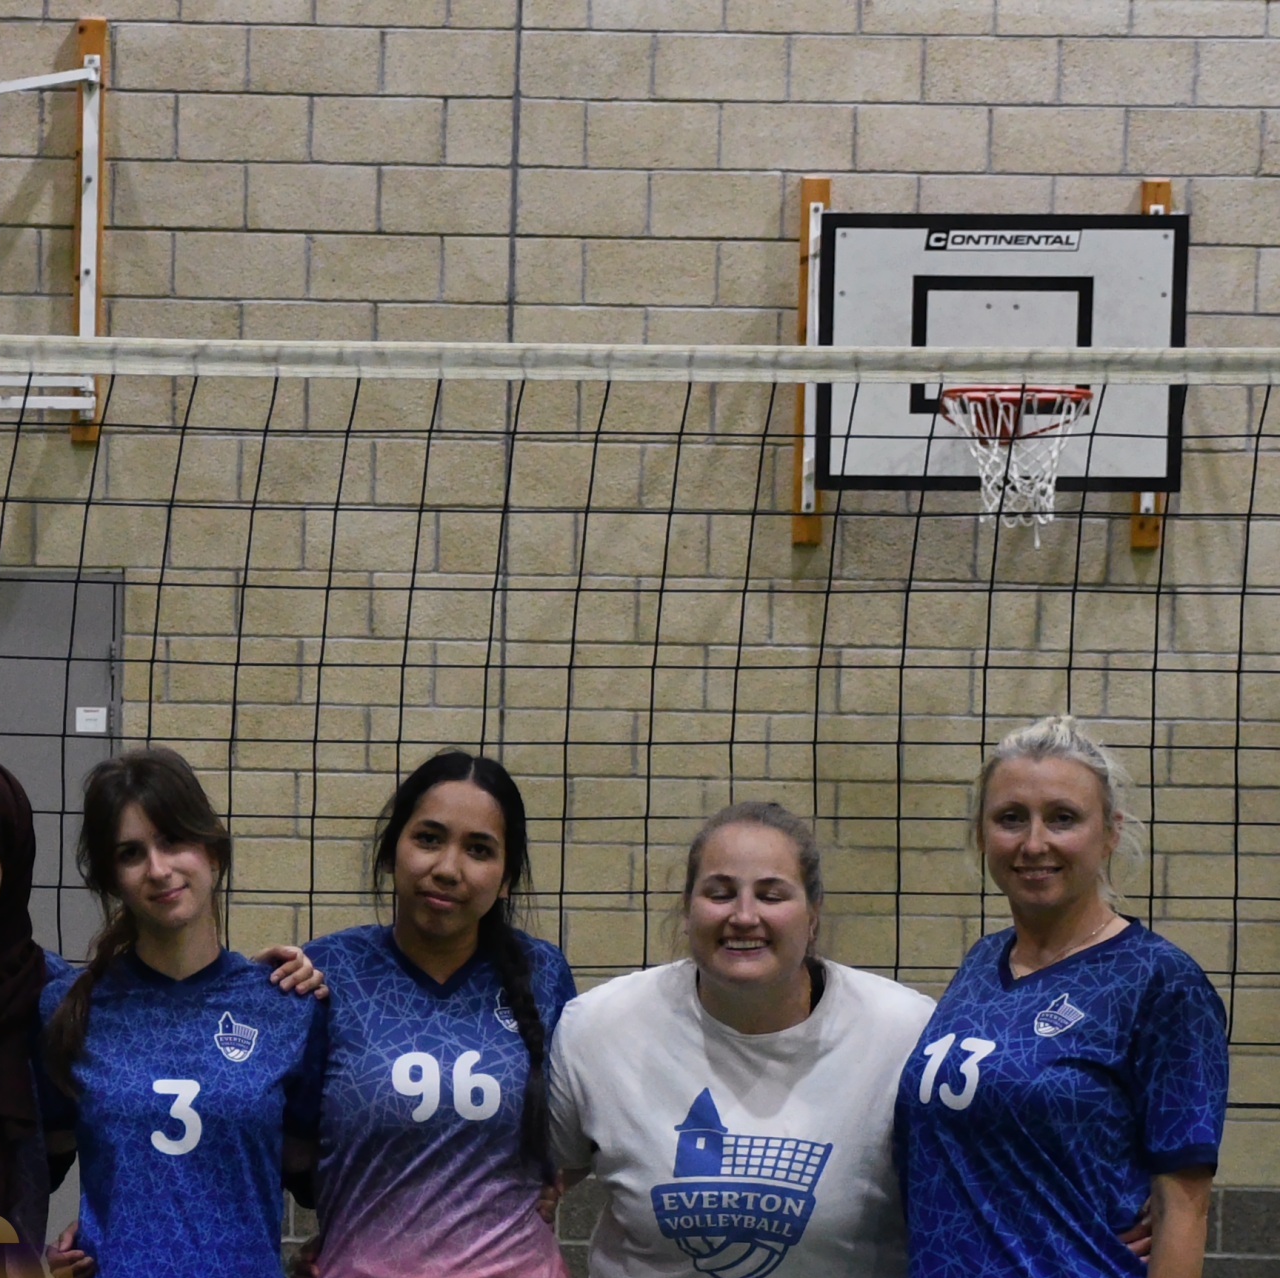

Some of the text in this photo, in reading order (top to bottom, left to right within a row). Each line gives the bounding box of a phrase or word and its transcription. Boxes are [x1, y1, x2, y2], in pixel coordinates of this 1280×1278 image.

[928, 232, 1076, 247] CONTINENTAL
[219, 1036, 251, 1046] EVERTON
[919, 1033, 996, 1110] 13
[392, 1050, 501, 1123] 96
[150, 1079, 202, 1156] 3
[661, 1191, 806, 1217] EVERTON
[664, 1213, 793, 1237] VOLLEYBALL
